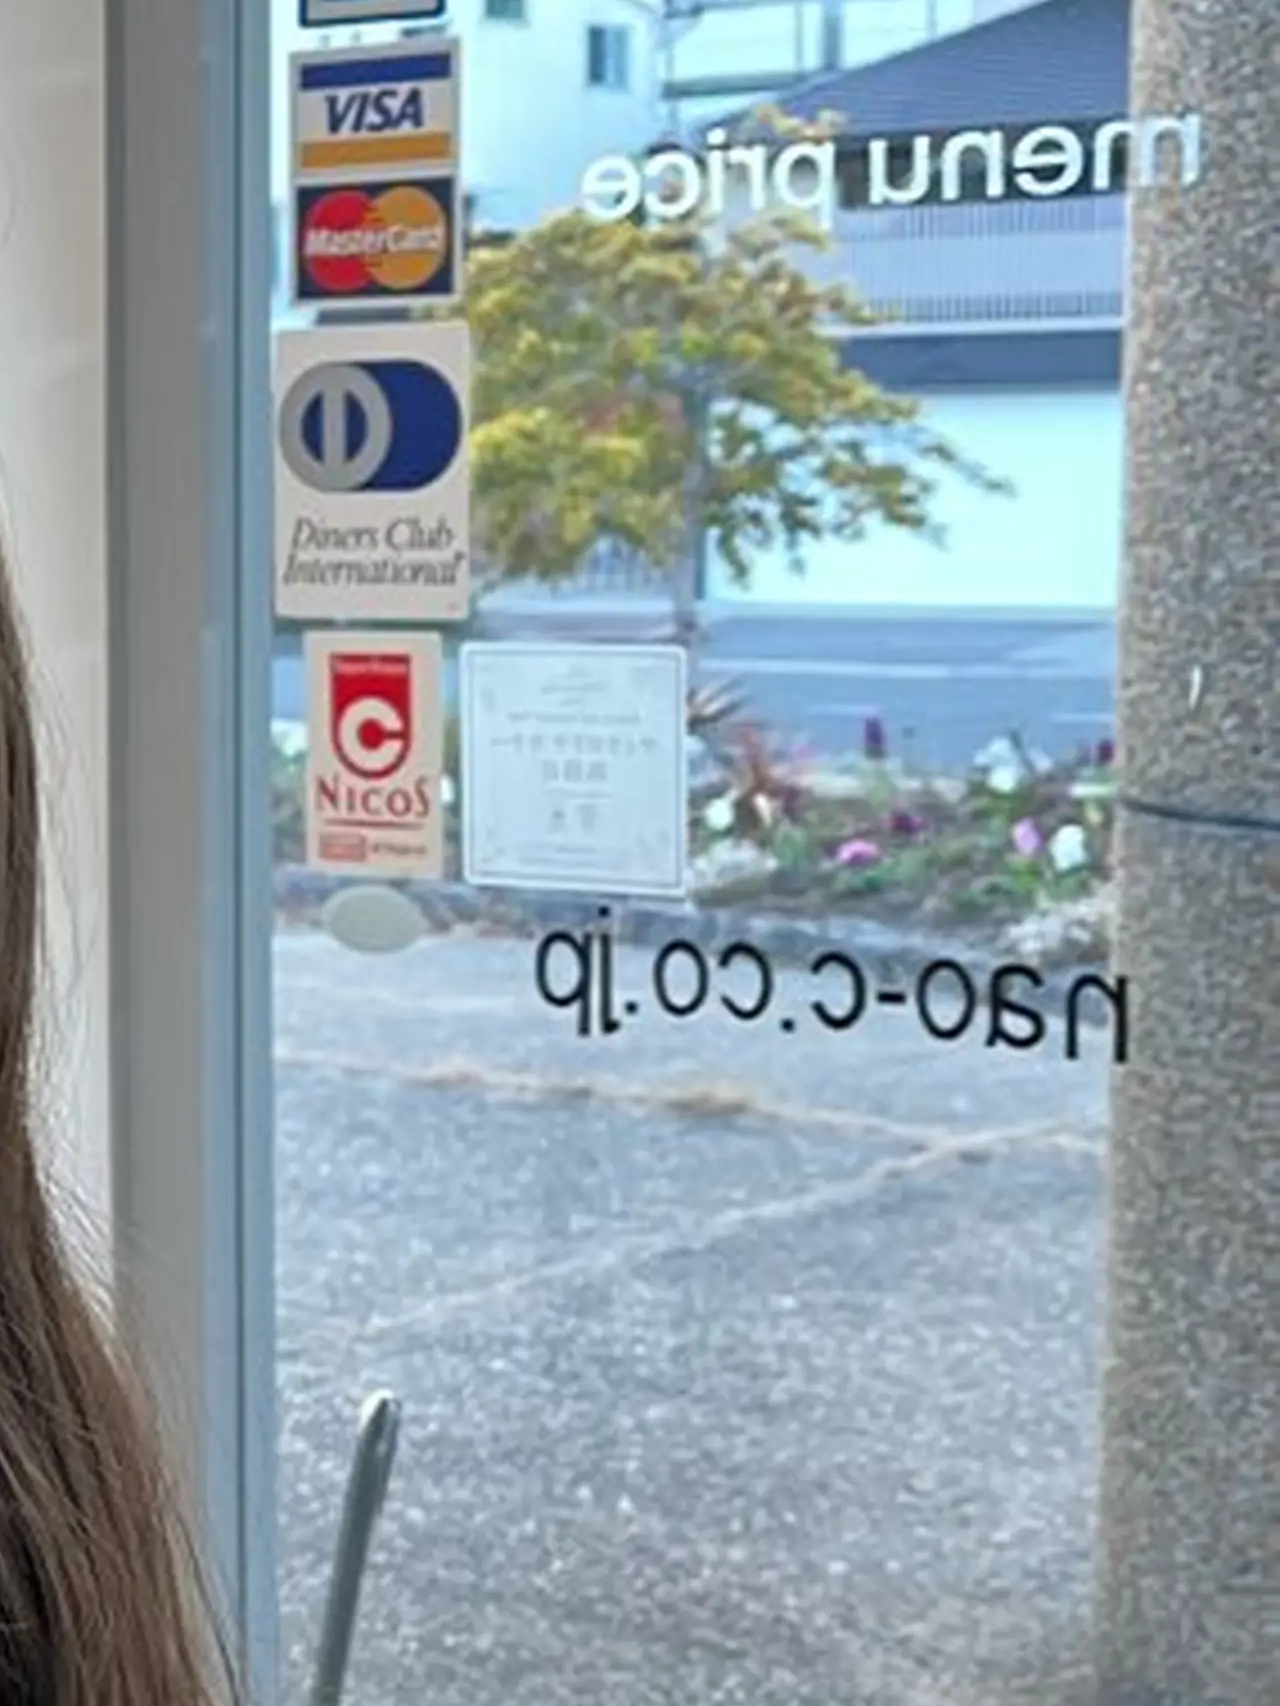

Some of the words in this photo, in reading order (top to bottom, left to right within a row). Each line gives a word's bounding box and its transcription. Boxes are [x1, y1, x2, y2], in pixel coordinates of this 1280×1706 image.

[325, 87, 424, 134] VISA
[304, 224, 445, 256] MasterCard
[292, 517, 379, 551] Diners
[386, 515, 455, 552] Club
[283, 551, 466, 586] International
[315, 770, 430, 819] NICOS
